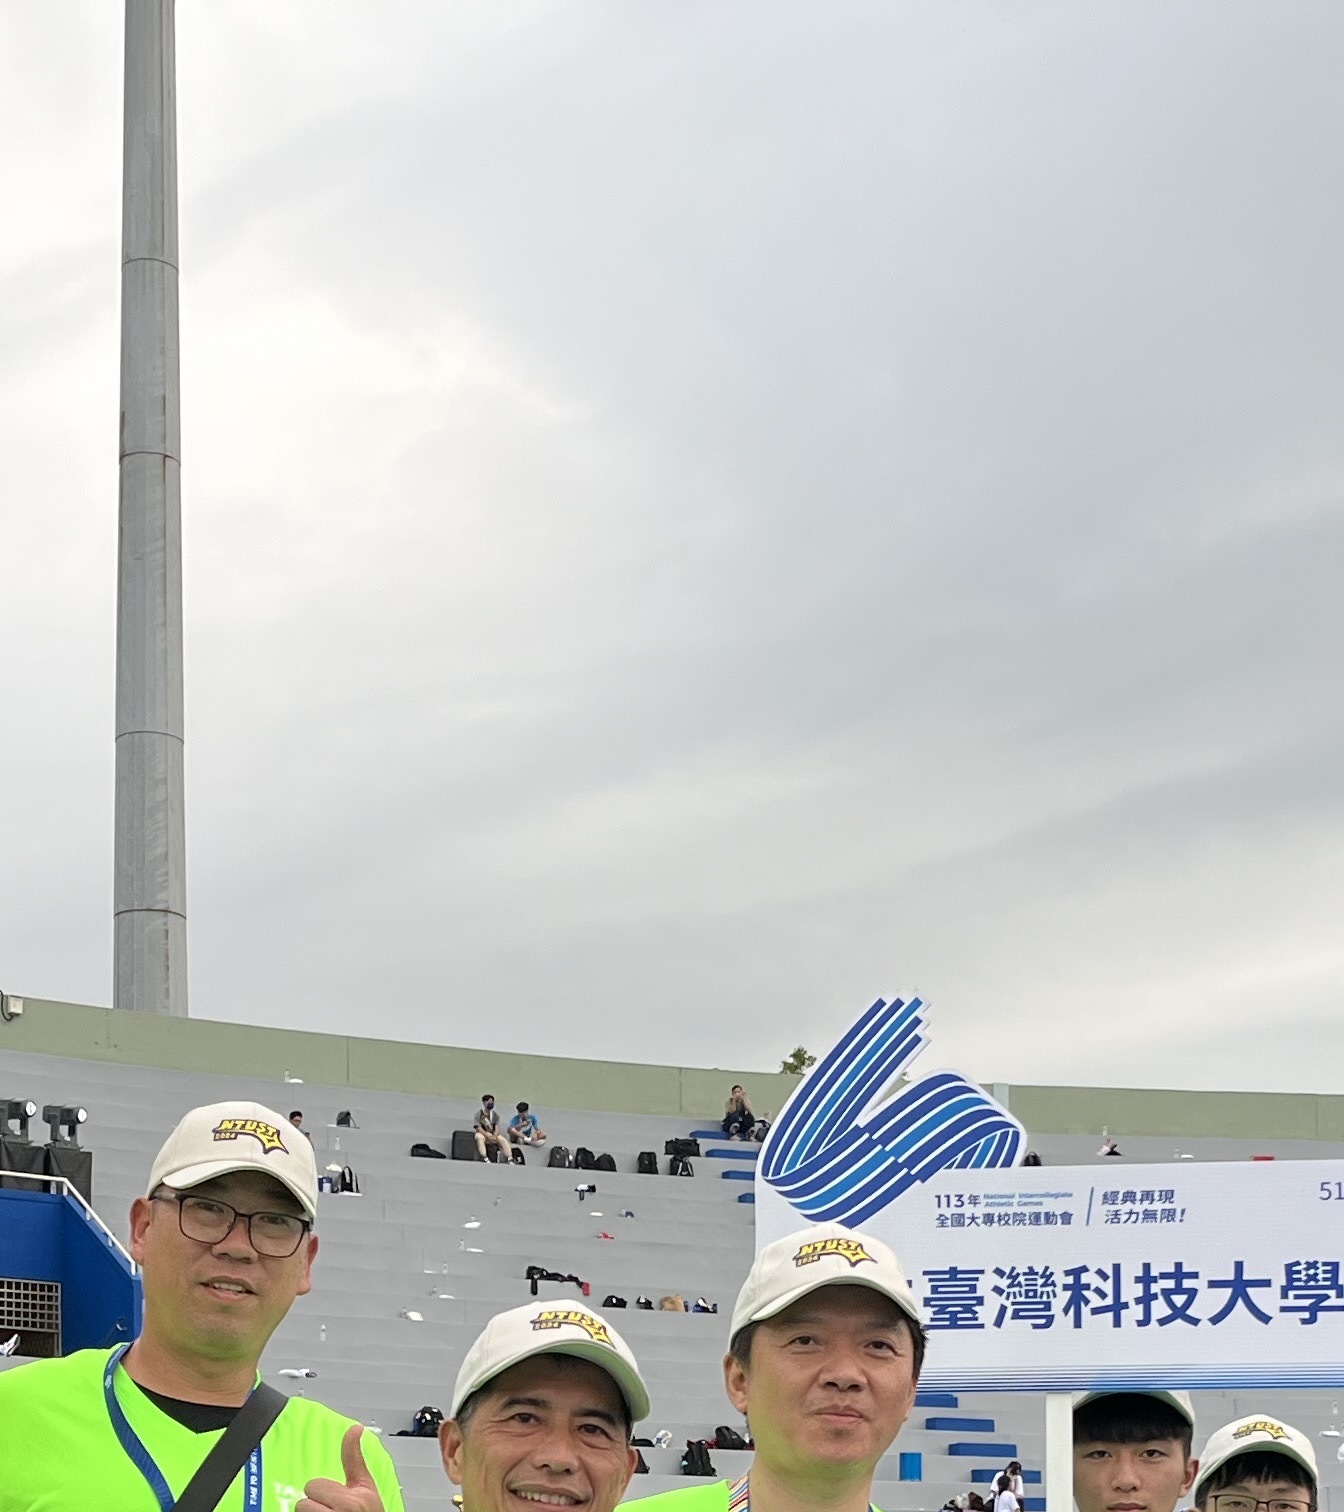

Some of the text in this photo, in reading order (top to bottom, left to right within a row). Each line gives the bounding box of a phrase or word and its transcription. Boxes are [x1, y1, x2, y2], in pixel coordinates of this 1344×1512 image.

[220, 1119, 279, 1137] NTUST
[934, 1193, 981, 1209] 113年
[1101, 1189, 1176, 1206] 經典再現
[935, 1211, 1074, 1229] 全國大專校院運動會
[1104, 1207, 1187, 1225] 活力無限!
[799, 1238, 860, 1256] NTUST
